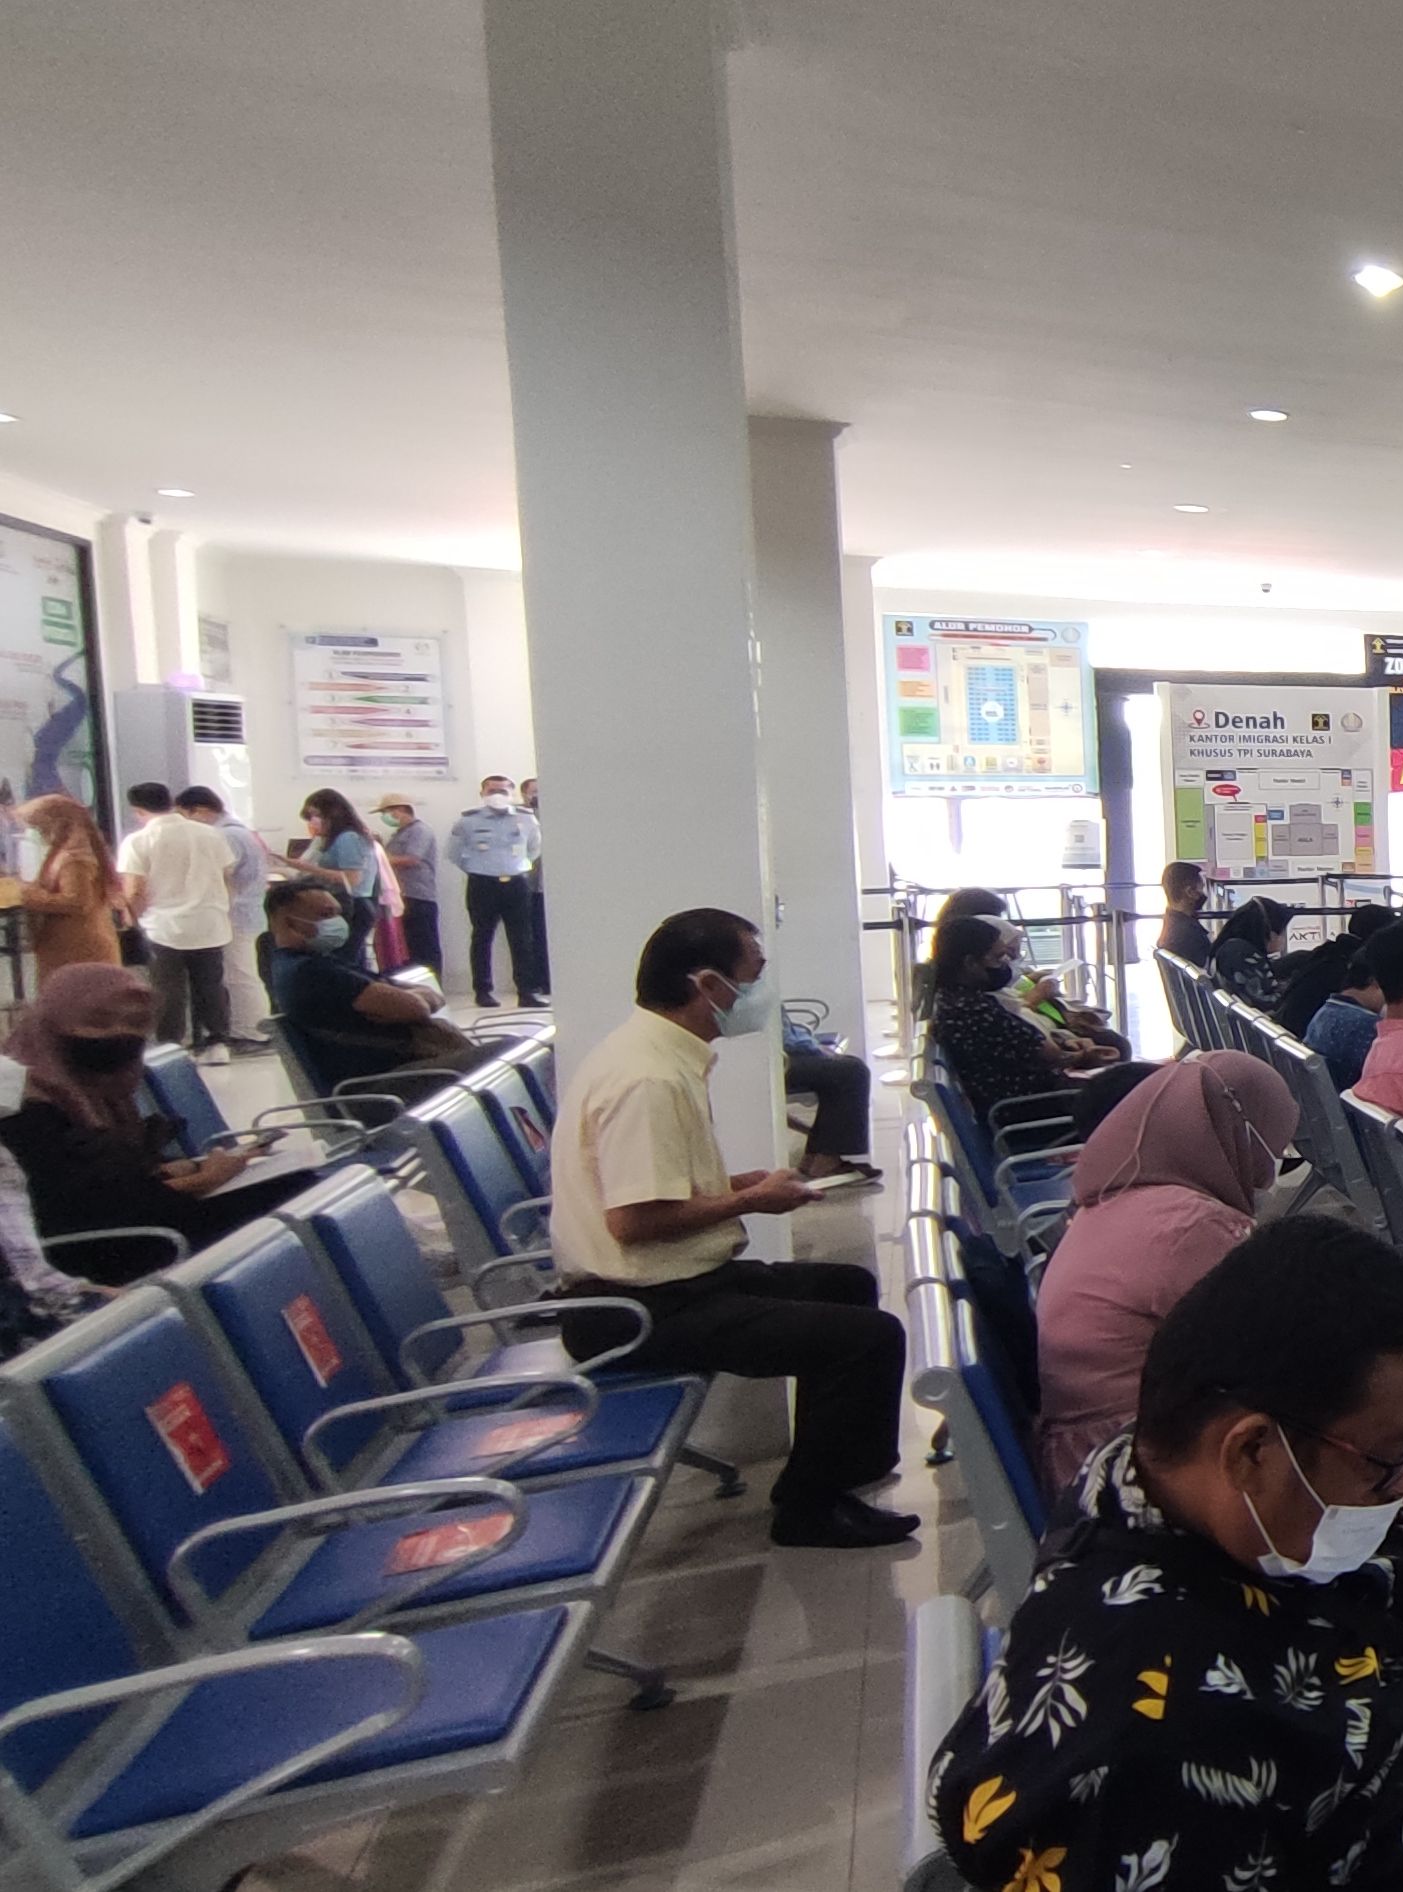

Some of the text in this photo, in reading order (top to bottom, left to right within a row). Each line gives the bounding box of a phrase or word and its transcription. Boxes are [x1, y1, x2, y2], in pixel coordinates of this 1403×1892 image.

[1214, 710, 1285, 730] Denah
[1188, 734, 1332, 745] KANTOR IMIGRASI KELAS I
[1189, 749, 1313, 759] KHUSUS TPI SURABAYA
